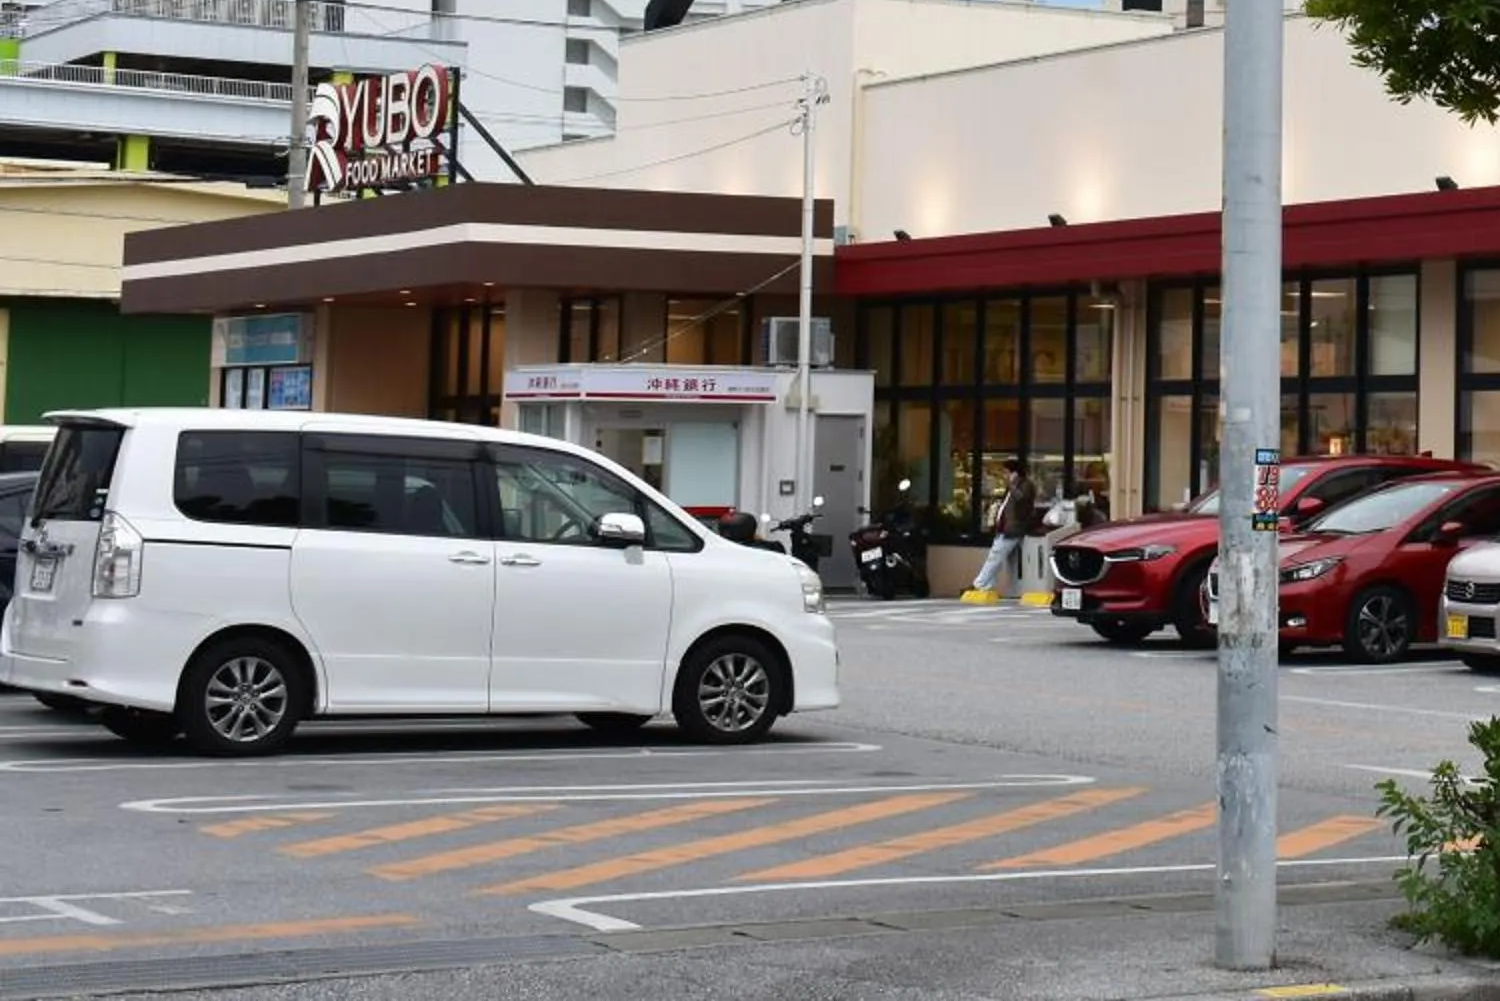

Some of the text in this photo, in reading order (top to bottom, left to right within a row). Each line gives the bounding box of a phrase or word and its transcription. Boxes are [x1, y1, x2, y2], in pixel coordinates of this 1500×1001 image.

[303, 63, 442, 192] RYUBO
[345, 148, 434, 187] FOOD MARKET
